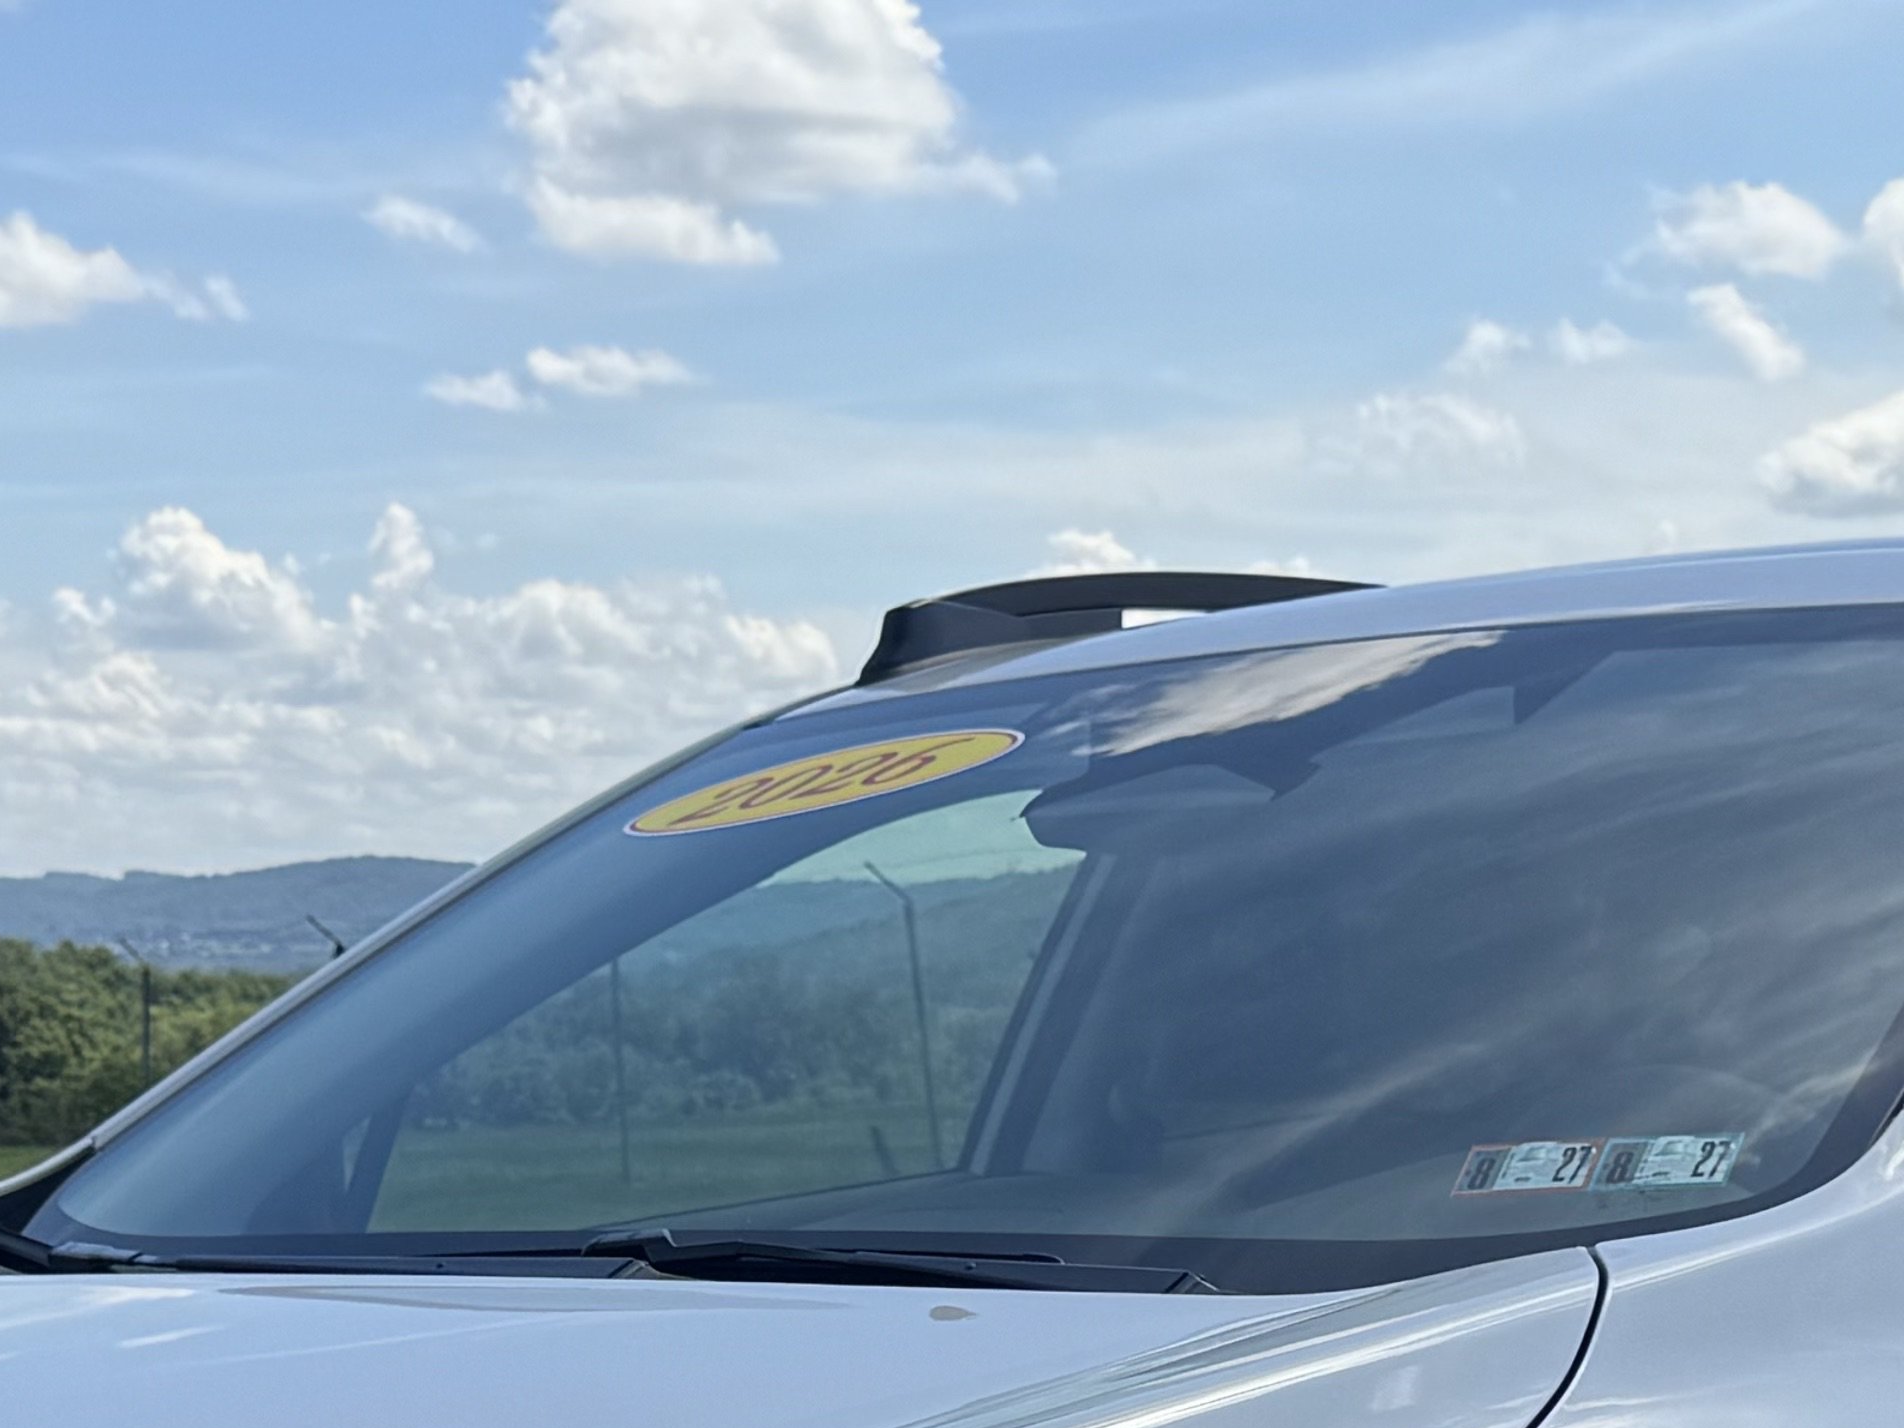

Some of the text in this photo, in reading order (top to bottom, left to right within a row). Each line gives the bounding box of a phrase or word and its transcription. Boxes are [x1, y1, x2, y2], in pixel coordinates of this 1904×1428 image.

[667, 737, 975, 827] 2026
[1467, 1146, 1593, 1190] 8 27
[1605, 1140, 1730, 1184] 8 27
